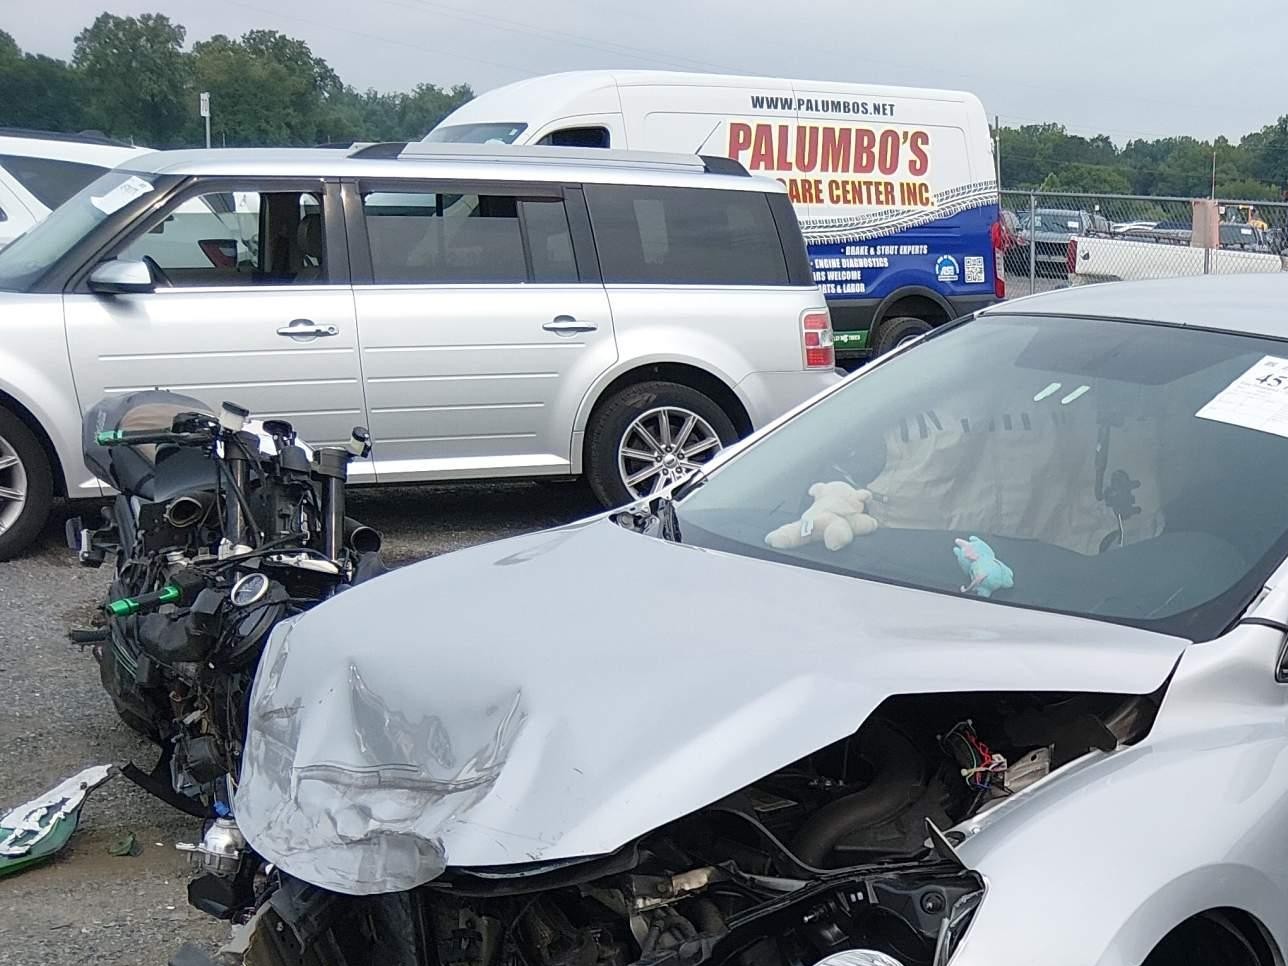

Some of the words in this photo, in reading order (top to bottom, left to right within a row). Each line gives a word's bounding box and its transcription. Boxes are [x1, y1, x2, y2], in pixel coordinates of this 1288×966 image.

[750, 94, 896, 117] WWW.PALUMBOS.NET
[728, 122, 930, 177] PALUMBO'S
[776, 177, 825, 204] ARE
[828, 179, 896, 206] CENTER
[899, 181, 935, 207] INC.
[845, 245, 868, 256] BRAKE
[869, 246, 875, 255] &
[876, 245, 899, 255] STRUT
[900, 244, 928, 255] EXPERTS
[814, 258, 841, 269] ENGINE
[841, 257, 889, 268] DIAGNOSTICS
[827, 270, 861, 281] WELCOME
[836, 284, 843, 293] &
[843, 283, 866, 293] LABOR
